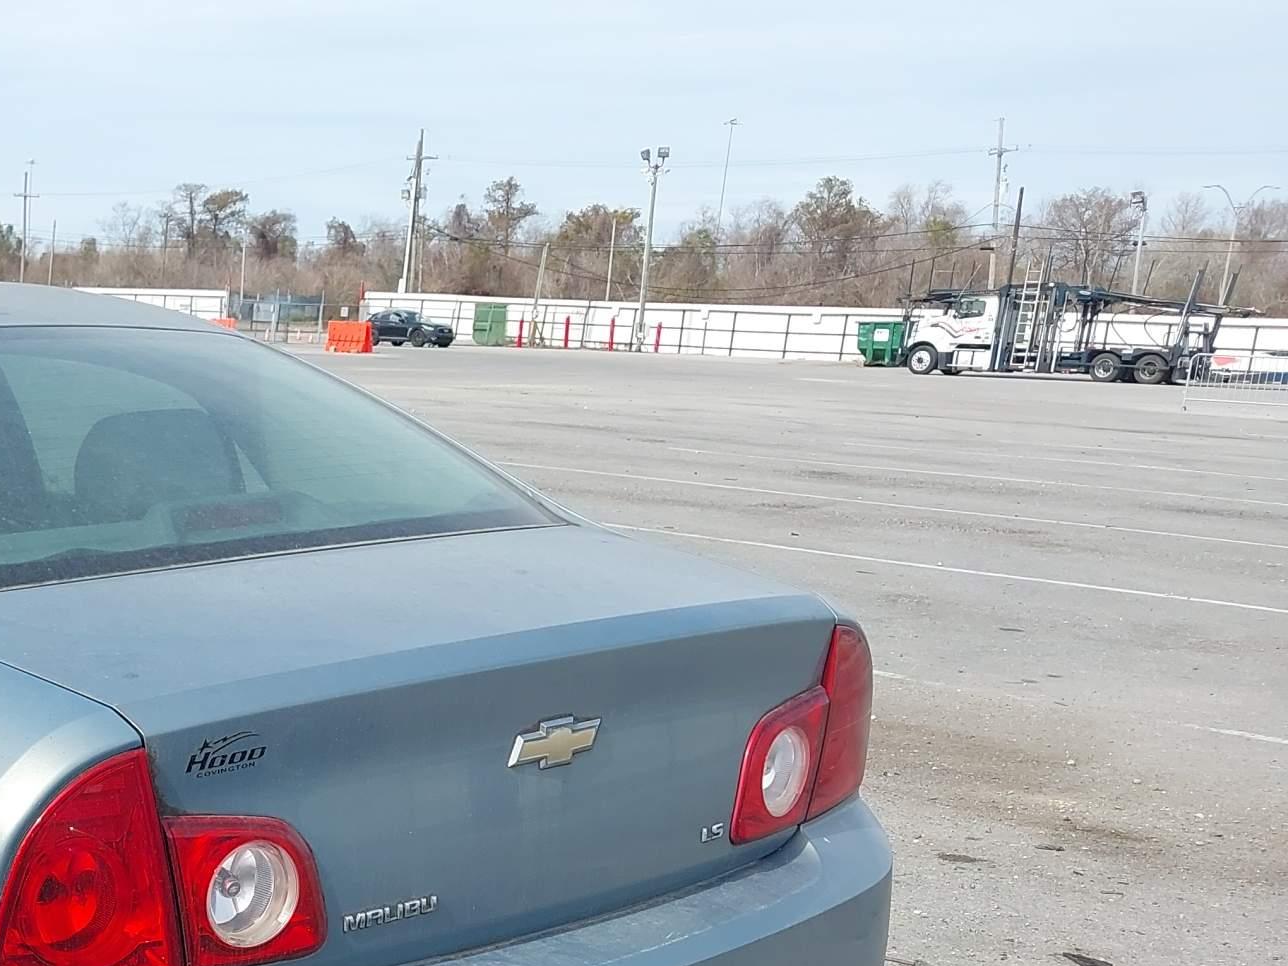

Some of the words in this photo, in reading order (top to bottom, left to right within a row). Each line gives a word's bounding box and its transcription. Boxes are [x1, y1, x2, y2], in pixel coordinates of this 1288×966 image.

[196, 761, 256, 778] COVINGTON
[701, 822, 724, 843] LS
[342, 895, 438, 933] MALIBU
